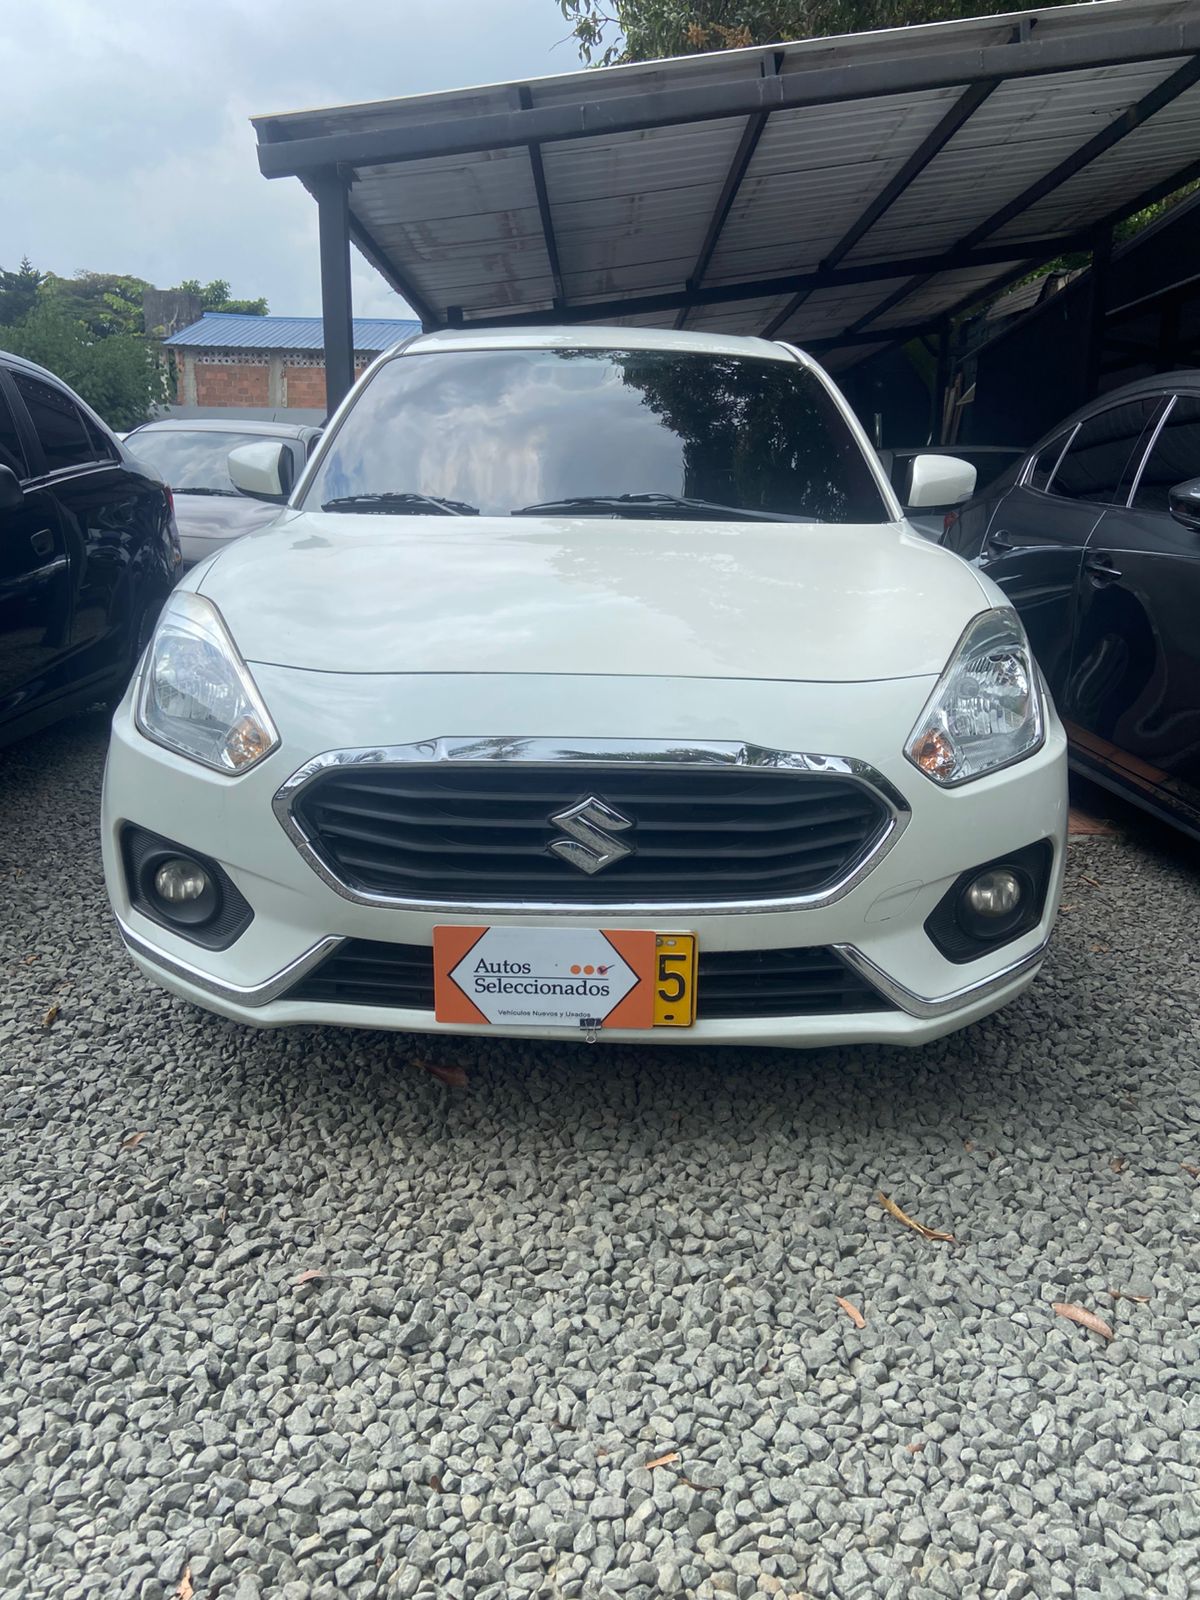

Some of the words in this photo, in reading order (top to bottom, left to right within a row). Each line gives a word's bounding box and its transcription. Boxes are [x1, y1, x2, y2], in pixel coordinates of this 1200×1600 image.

[473, 958, 531, 974] Autos
[474, 977, 610, 997] Seleccionados
[658, 954, 687, 1003] 5
